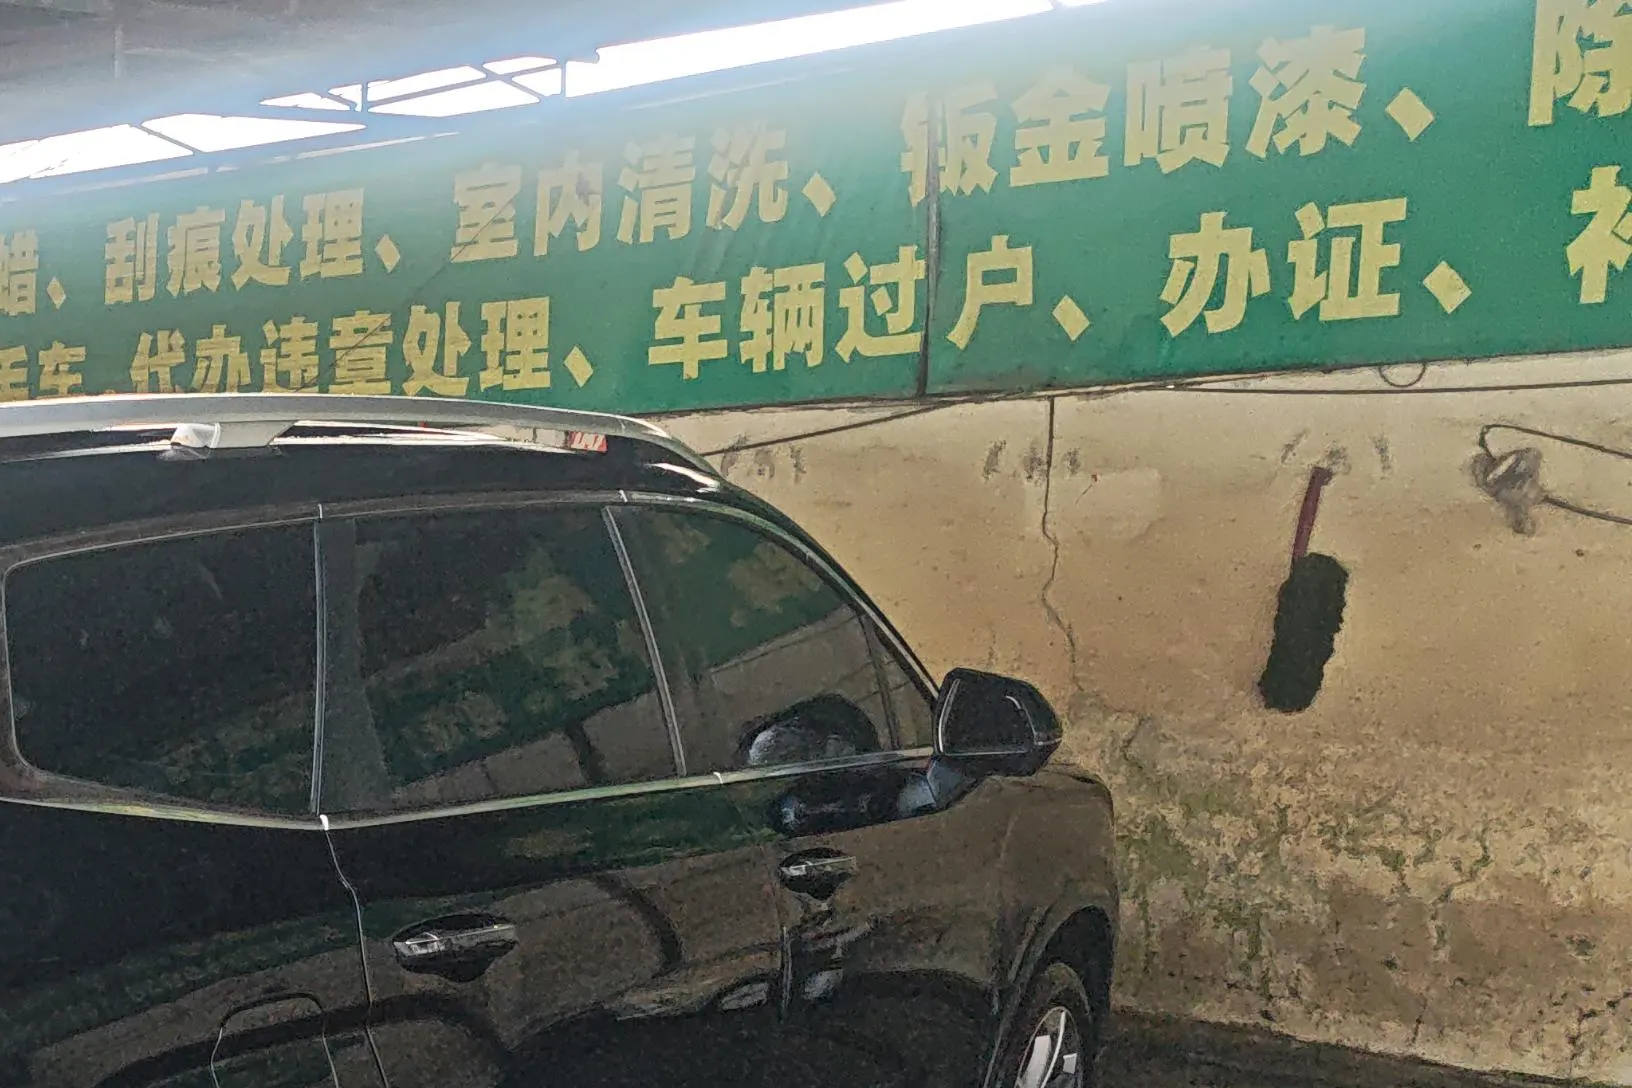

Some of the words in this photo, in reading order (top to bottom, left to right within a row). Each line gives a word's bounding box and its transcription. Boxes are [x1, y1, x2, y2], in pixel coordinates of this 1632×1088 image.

[648, 233, 1091, 381] 车辆过户、
[1161, 197, 1473, 339] 办证、
